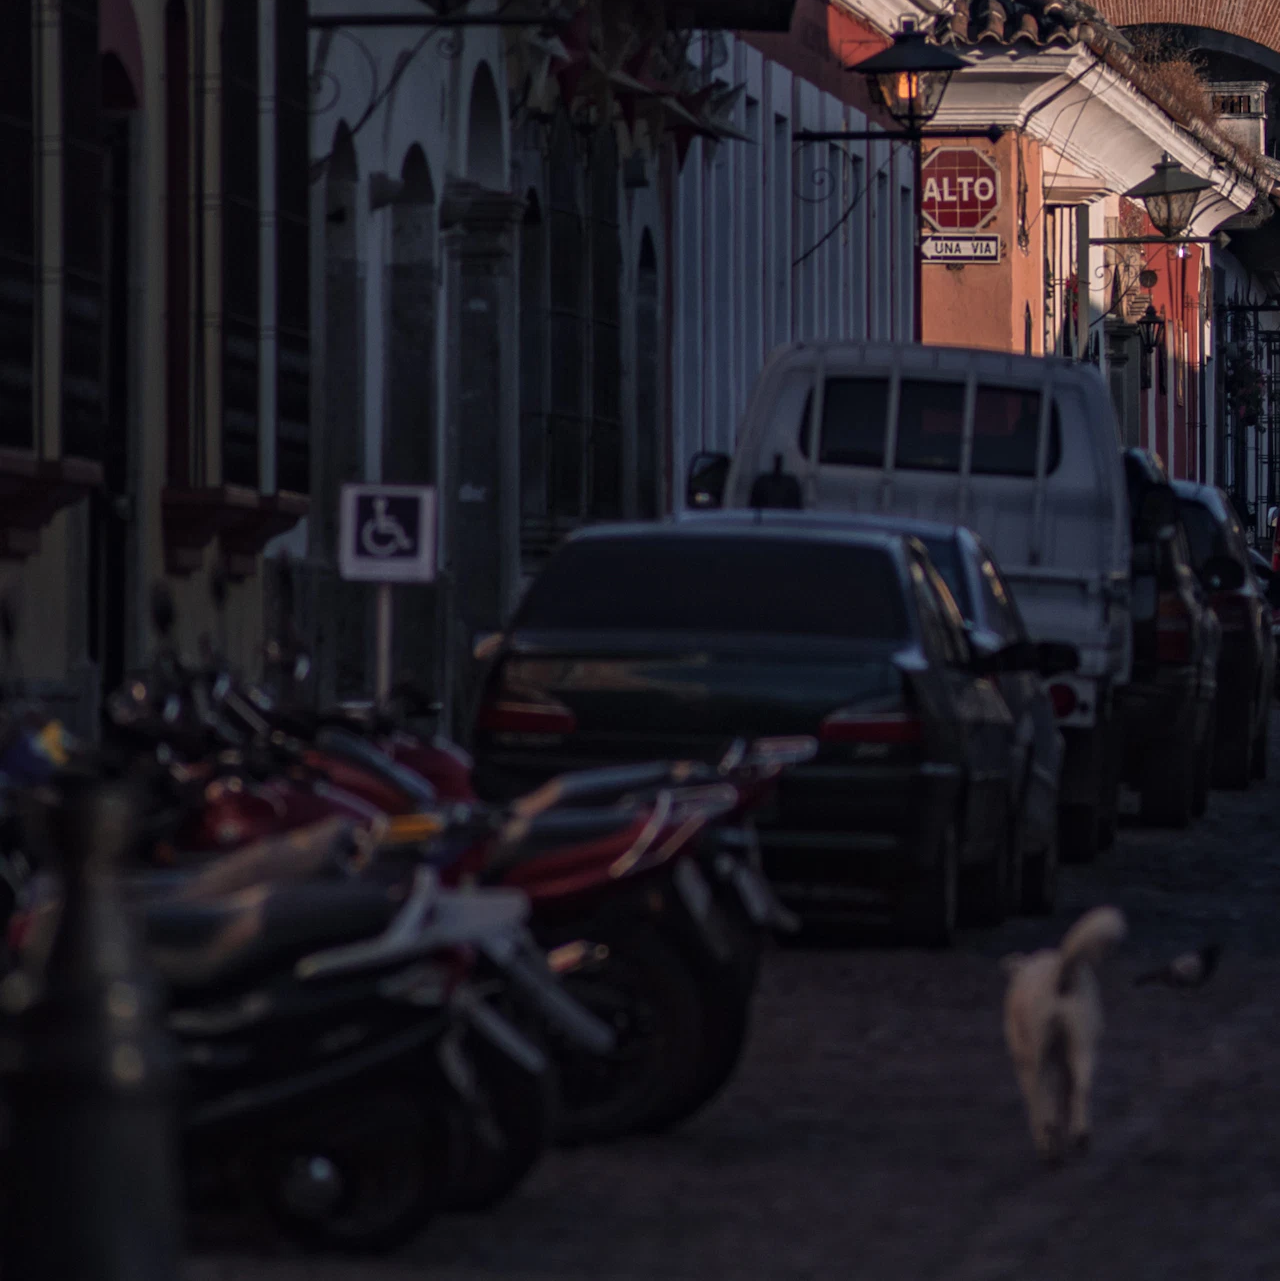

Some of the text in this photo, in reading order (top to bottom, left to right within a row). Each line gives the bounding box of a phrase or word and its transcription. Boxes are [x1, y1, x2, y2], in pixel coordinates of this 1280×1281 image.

[923, 177, 995, 202] ALTO
[935, 242, 992, 254] UNA VIA
